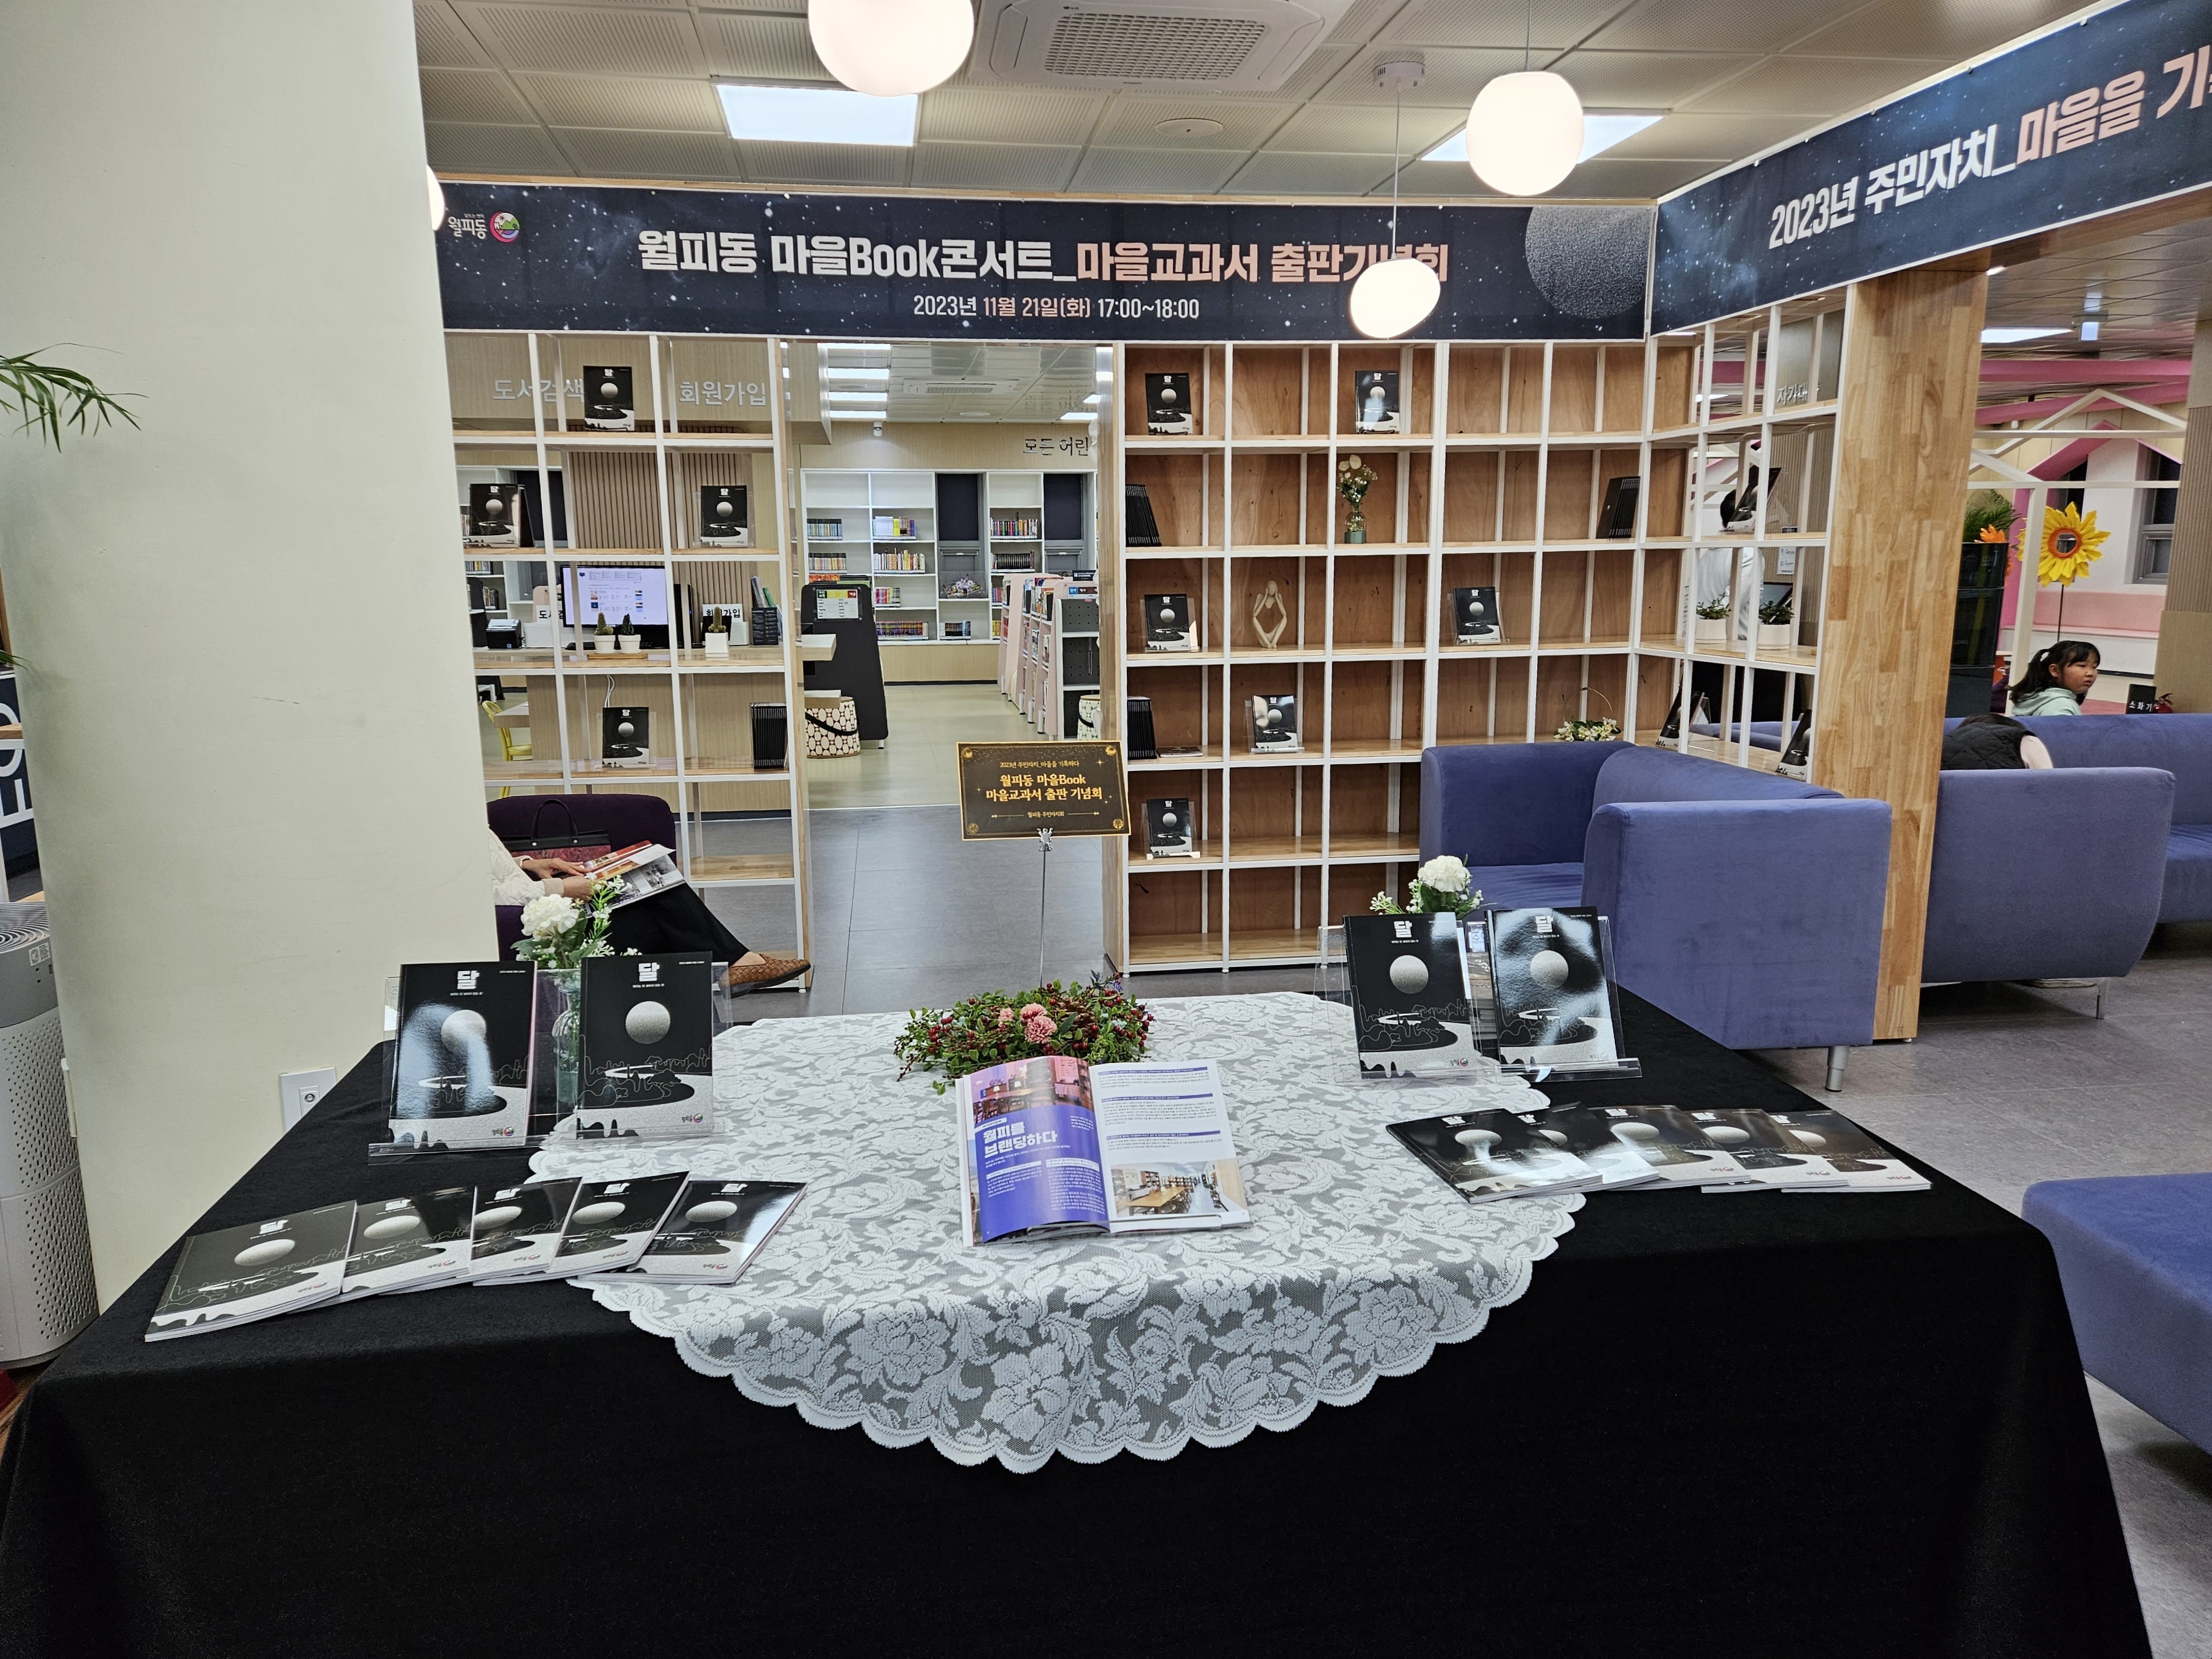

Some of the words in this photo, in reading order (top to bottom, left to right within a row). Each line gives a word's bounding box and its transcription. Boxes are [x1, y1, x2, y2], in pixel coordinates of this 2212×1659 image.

[1768, 176, 1859, 250] 2023년
[2156, 44, 2212, 119] 기
[448, 216, 488, 240] 월피동
[639, 230, 757, 273] 월피동
[913, 295, 977, 317] 2023년
[983, 297, 1016, 317] 11월
[1022, 297, 1091, 318] 21일(화)
[1098, 298, 1200, 320] 17:00~18:00
[679, 381, 766, 406] 회원가입
[1776, 381, 1819, 405] 자가대
[1023, 438, 1054, 455] 모든
[2129, 700, 2153, 712] 소화기
[1000, 774, 1034, 787] 월피동
[1037, 773, 1086, 787] 마을Book
[986, 788, 1042, 802] 마을교과서
[1044, 787, 1068, 801] 출판
[1071, 787, 1102, 800] 기념회
[1394, 921, 1412, 938] 달
[1536, 915, 1554, 933] 달
[457, 970, 480, 990] 달
[639, 962, 660, 982] 달
[983, 1121, 1025, 1144] 월피를
[984, 1131, 1058, 1158] 브랜딩하다
[260, 1219, 289, 1234] 달
